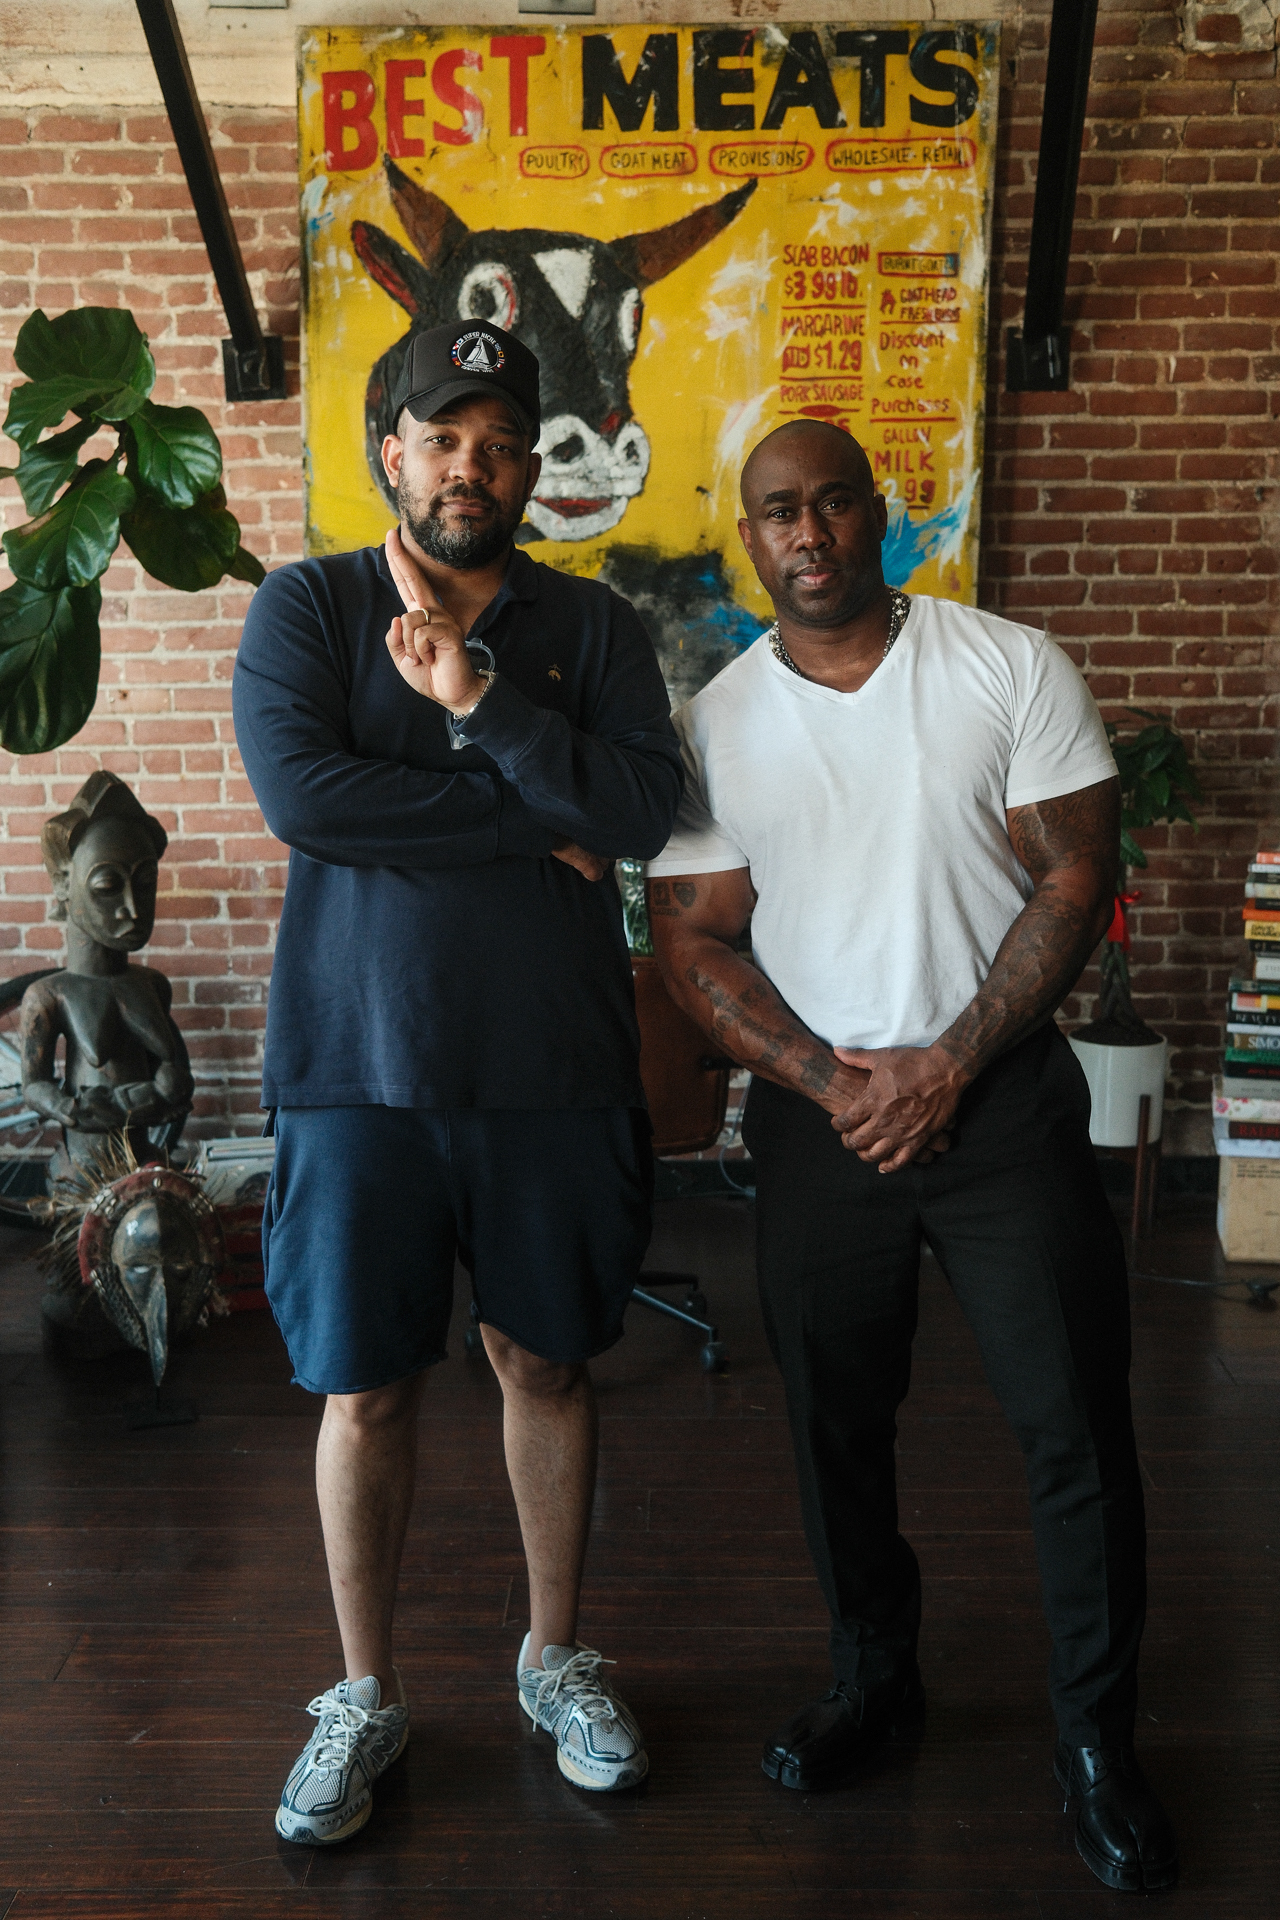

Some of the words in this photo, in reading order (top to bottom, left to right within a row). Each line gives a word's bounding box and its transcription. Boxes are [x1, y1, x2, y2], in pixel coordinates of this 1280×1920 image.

[321, 35, 547, 172] BEST
[581, 29, 980, 132] MEATS
[526, 151, 584, 171] POULTRY
[610, 152, 646, 169] GOAT
[652, 151, 688, 170] MEAT
[718, 149, 806, 168] PROVISIONS
[783, 244, 818, 267] SLAB
[821, 242, 870, 267] BACON
[781, 313, 866, 337] MARGARINE
[879, 330, 945, 351] Discount
[814, 339, 862, 372] $1.29
[882, 426, 932, 445] GALLON
[873, 450, 935, 473] MILK
